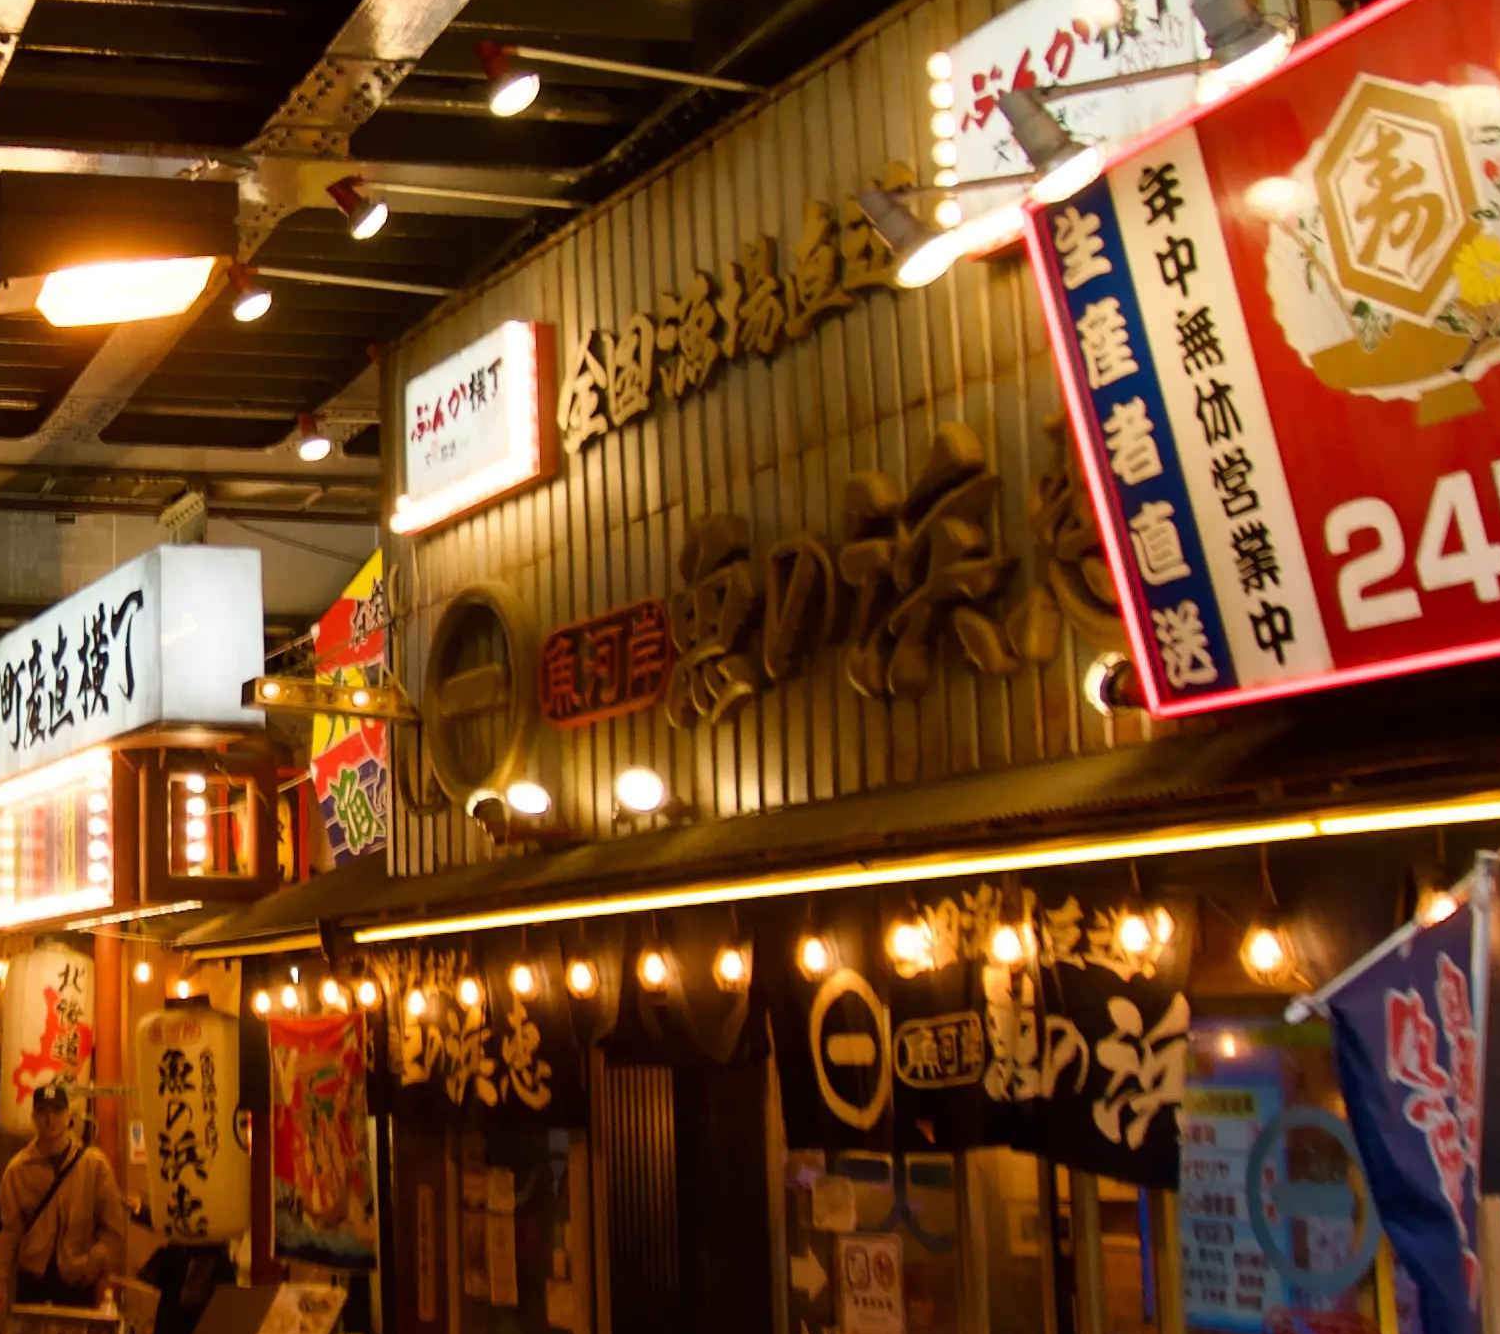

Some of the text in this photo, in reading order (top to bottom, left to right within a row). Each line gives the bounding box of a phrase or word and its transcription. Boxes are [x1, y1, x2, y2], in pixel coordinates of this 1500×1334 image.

[1052, 205, 1220, 692] 生産者直送
[1135, 161, 1298, 663] 年中無休営業中
